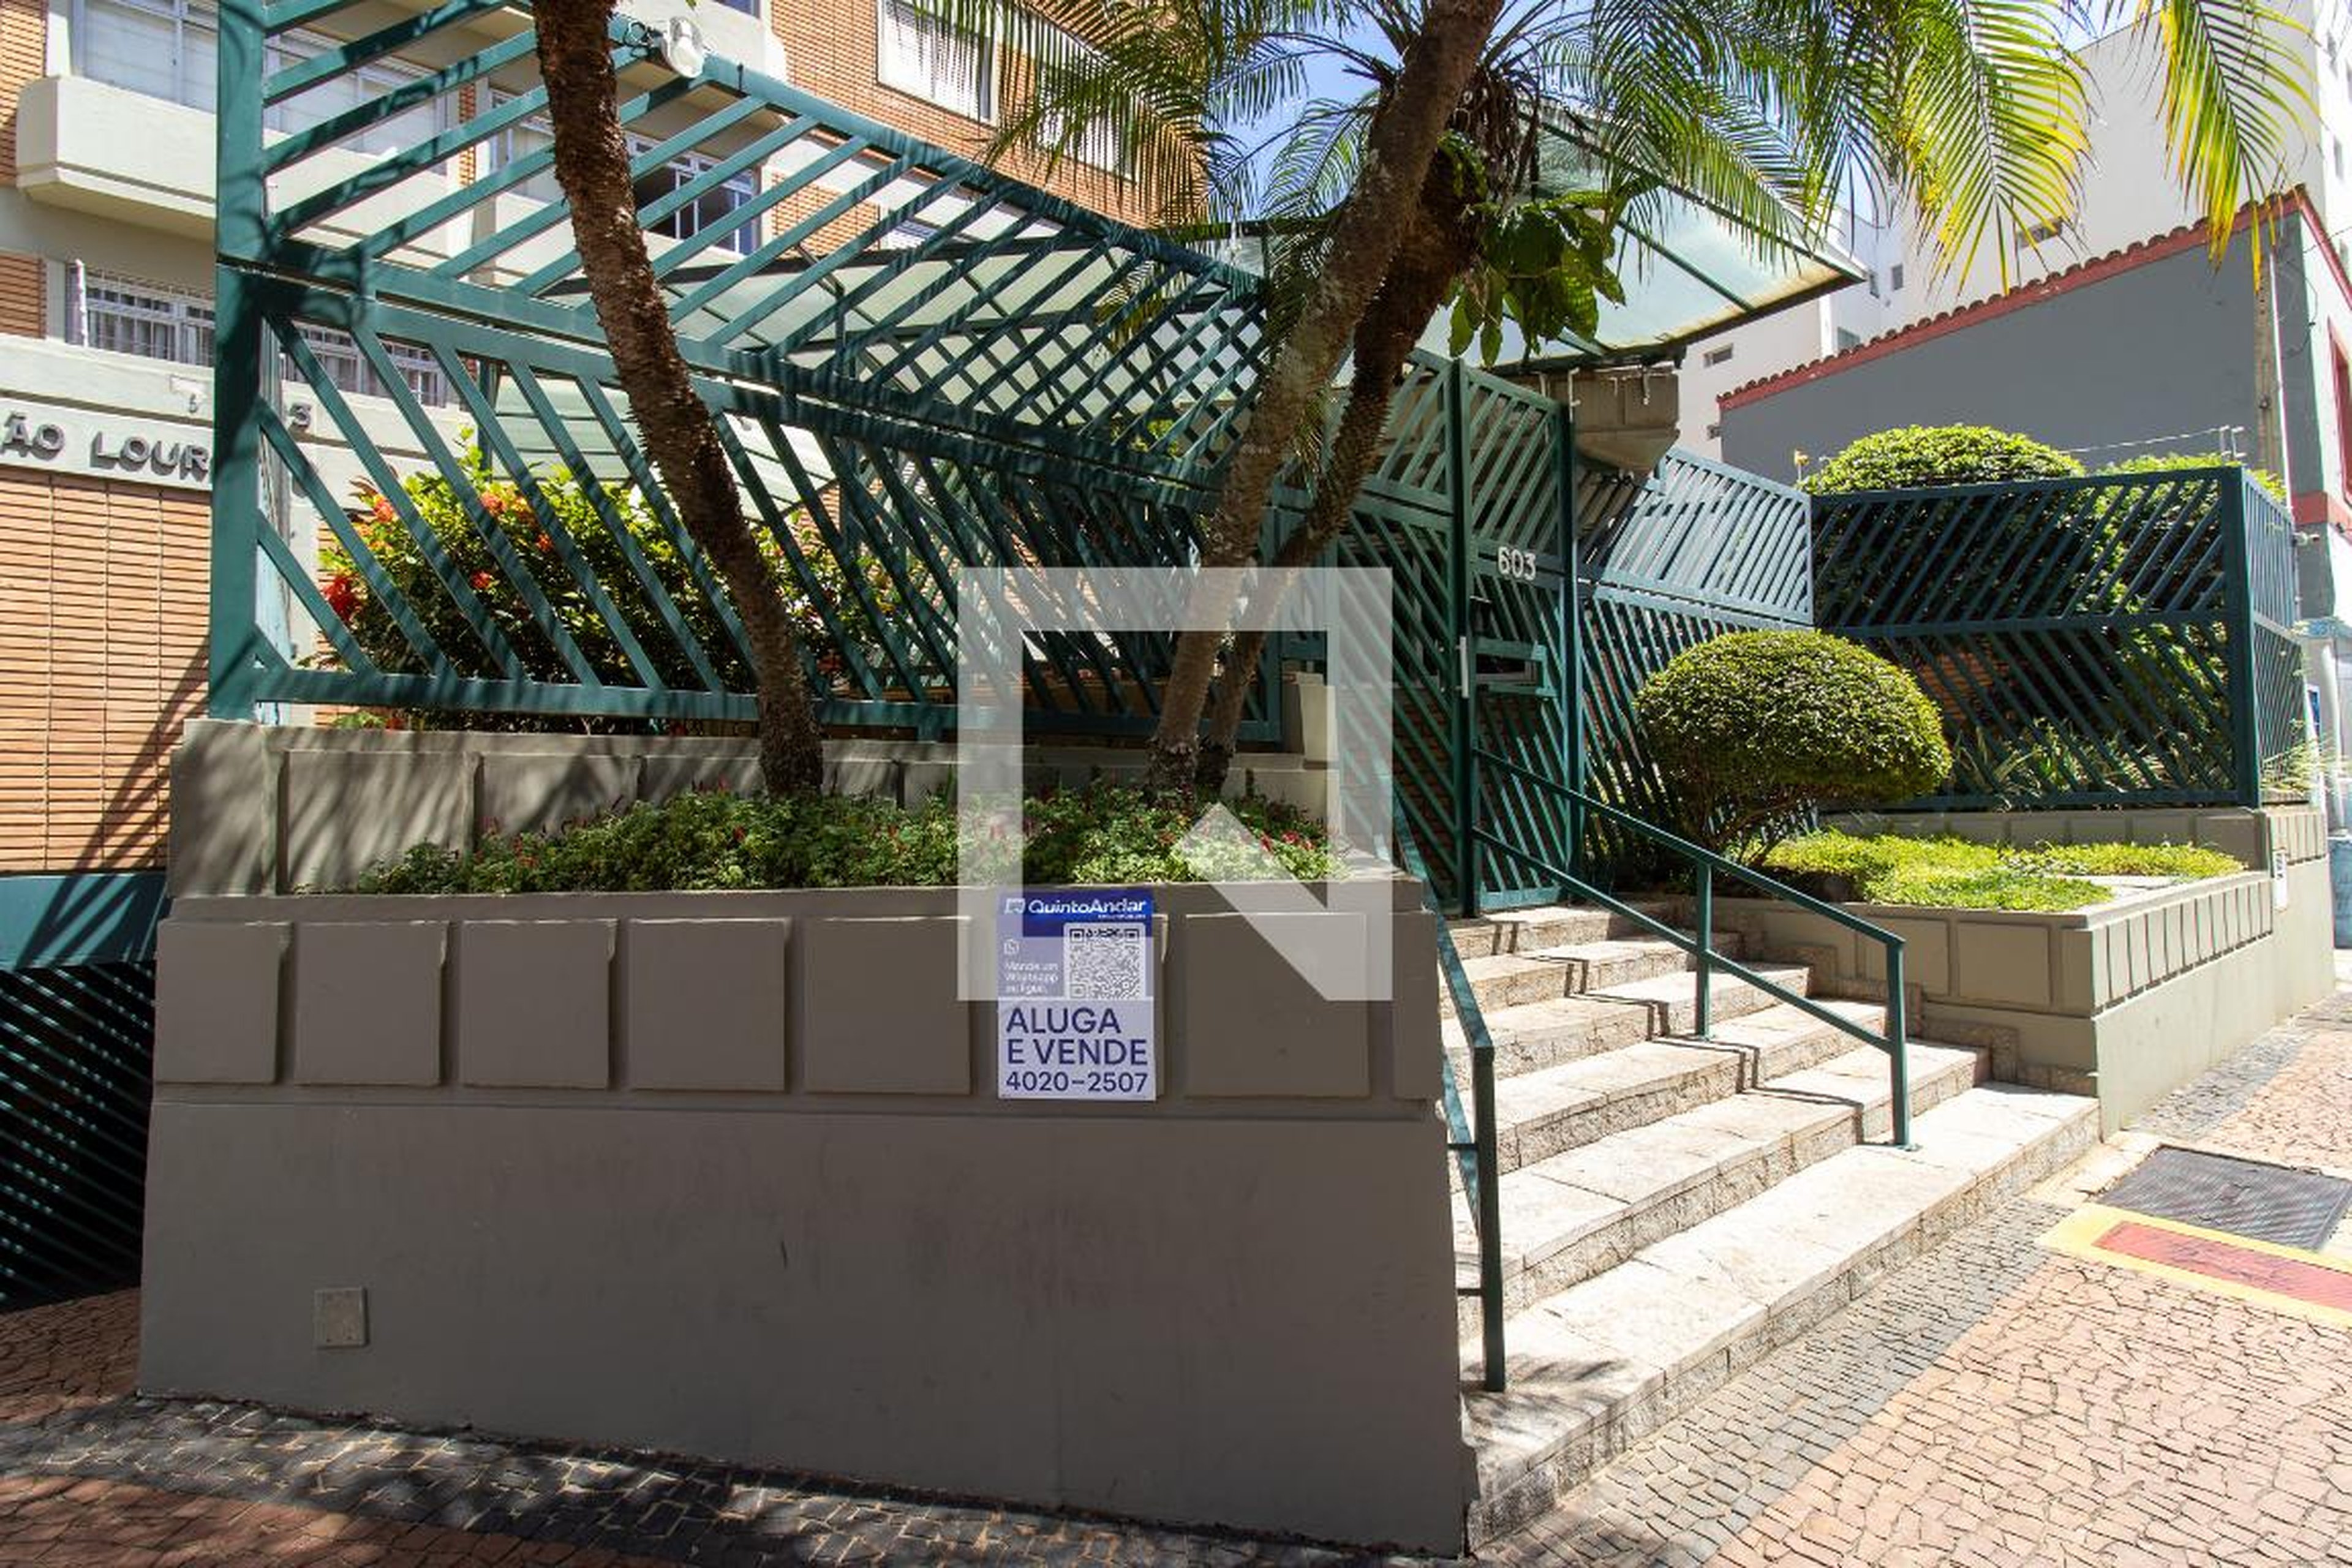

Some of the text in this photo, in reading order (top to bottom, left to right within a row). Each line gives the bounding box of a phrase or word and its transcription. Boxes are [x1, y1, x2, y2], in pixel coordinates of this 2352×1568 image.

[91, 431, 212, 480] LOUR
[1498, 546, 1536, 581] 603
[1028, 898, 1147, 914] QuintoAndar
[1006, 1006, 1122, 1035] ALUGA
[1008, 1038, 1148, 1066] E VENDE
[1006, 1071, 1148, 1093] 4020-2507
